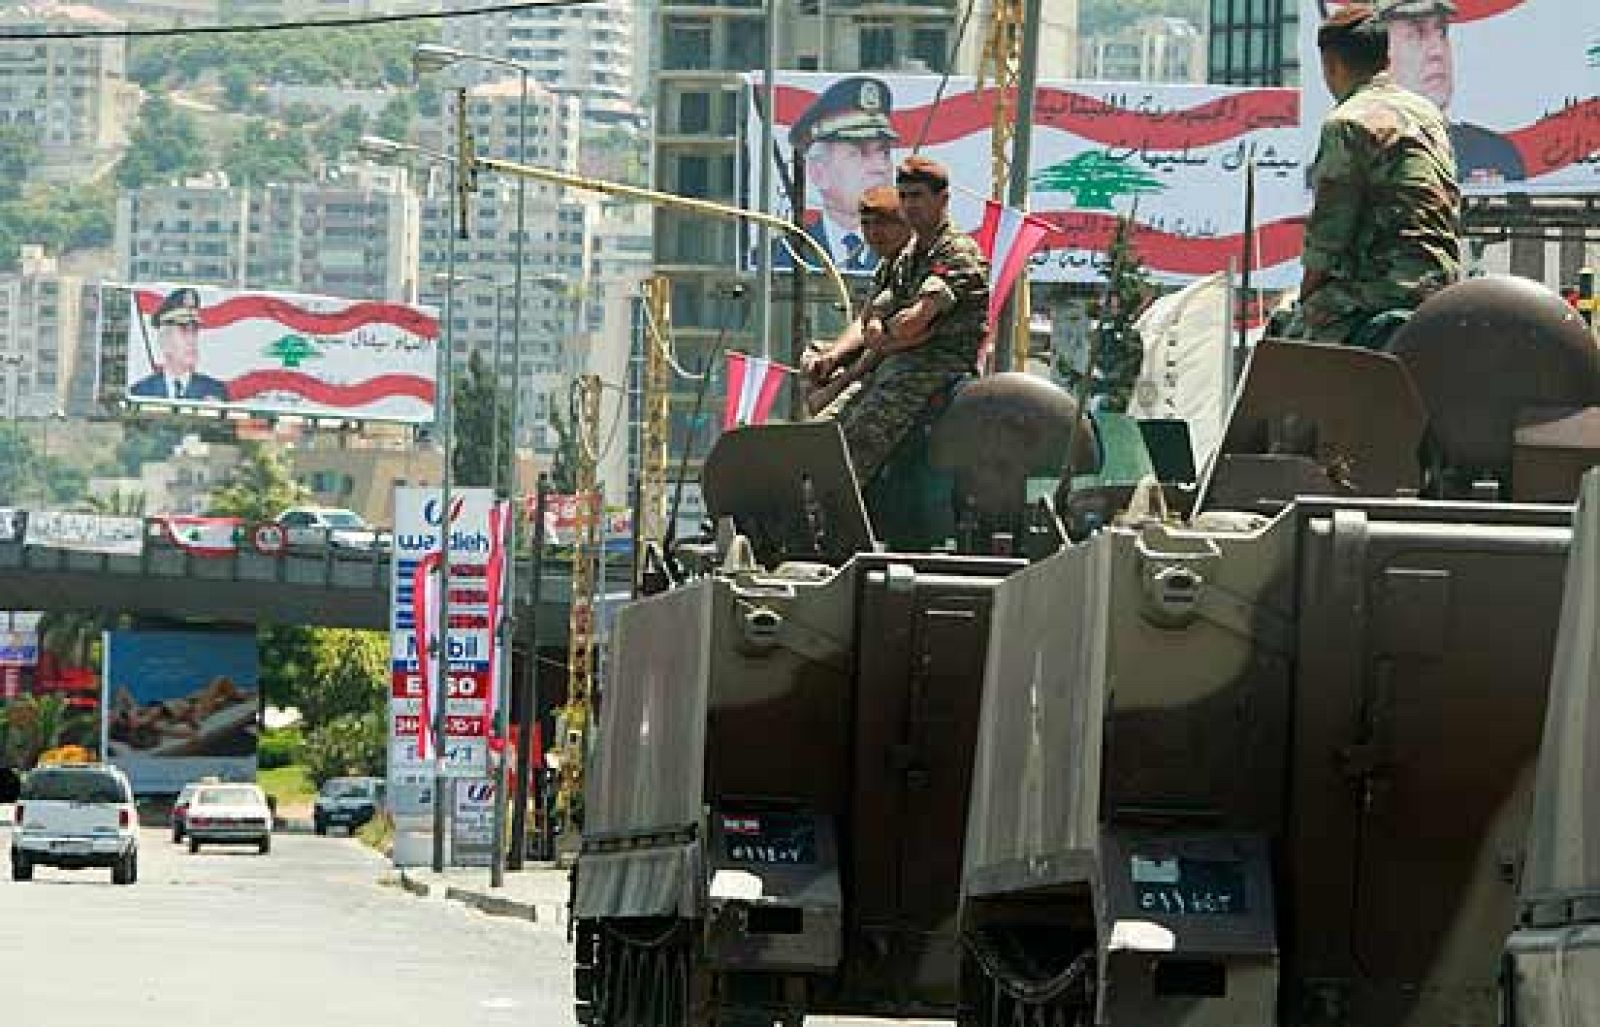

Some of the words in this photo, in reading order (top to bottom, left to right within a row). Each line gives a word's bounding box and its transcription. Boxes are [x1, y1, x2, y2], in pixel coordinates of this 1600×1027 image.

[398, 529, 490, 553] wadieh
[407, 634, 478, 657] Mbil
[406, 675, 476, 696] ESO
